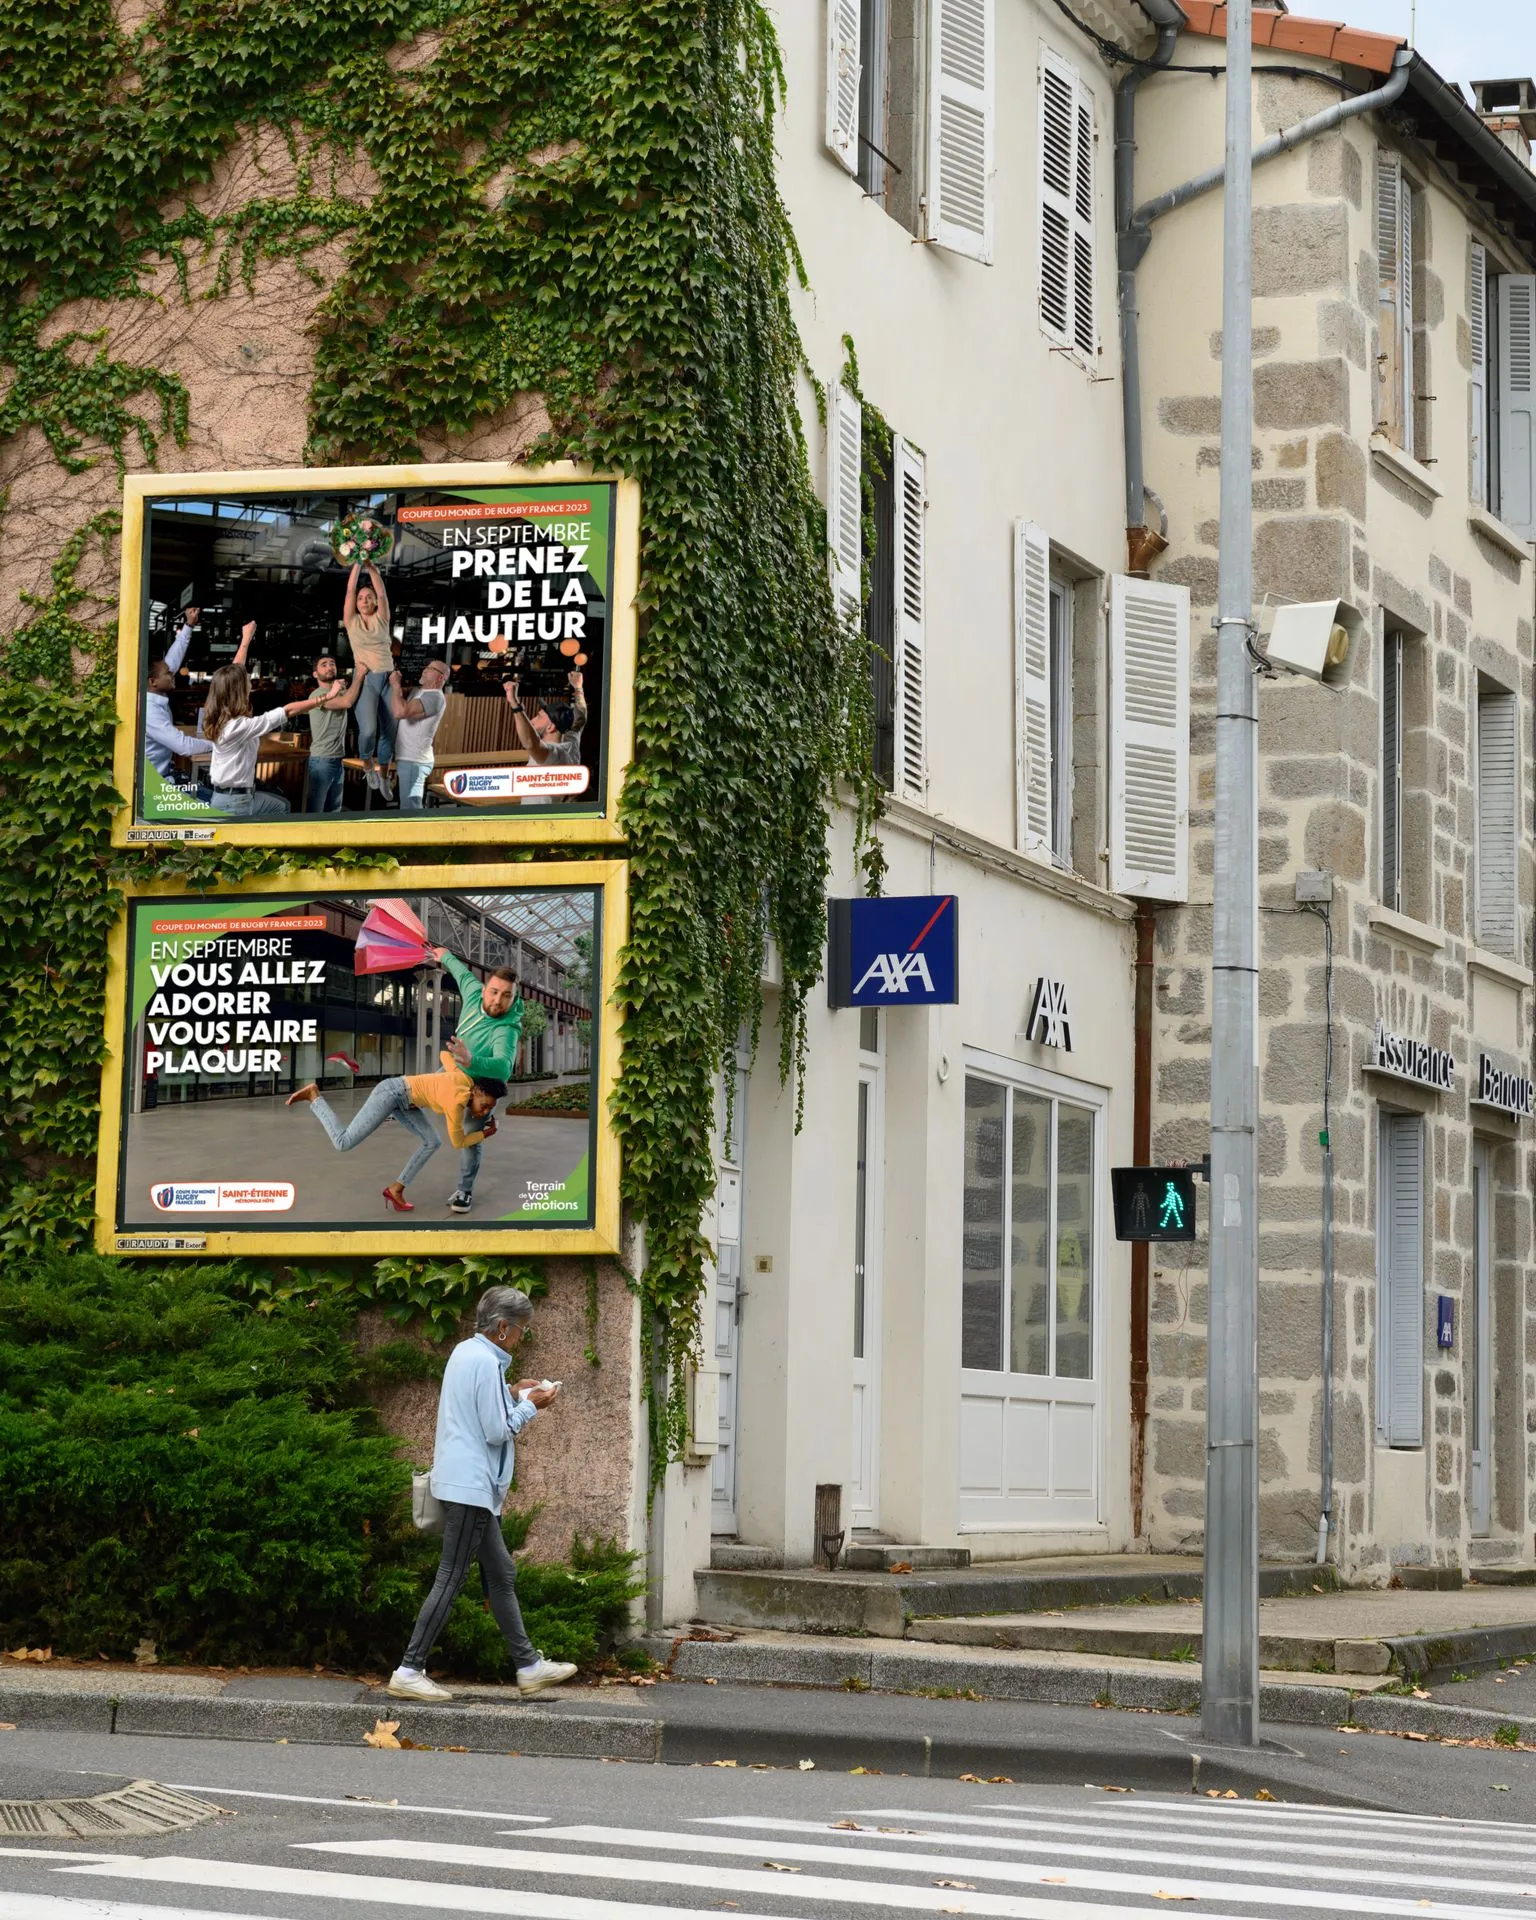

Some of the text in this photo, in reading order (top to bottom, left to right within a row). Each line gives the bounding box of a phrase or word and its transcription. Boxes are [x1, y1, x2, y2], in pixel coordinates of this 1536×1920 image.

[402, 503, 588, 519] COUPE DU MONDE DE RUGBY FRANCE 2023
[443, 522, 591, 546] EN SEPTEMBRE
[452, 544, 589, 578] PRENEZ
[487, 578, 588, 609] DE LA
[421, 611, 587, 645] HAUTEUR
[160, 782, 198, 793] Terrain
[516, 772, 583, 783] SAINT-ÉTIENNE
[156, 801, 210, 812] émotions
[161, 793, 182, 801] vos
[156, 923, 183, 931] COUPE
[197, 922, 227, 930] MONDE
[229, 921, 240, 929] DE
[241, 920, 269, 929] RUGBY
[269, 920, 302, 928] FRANCE
[303, 919, 323, 927] 2023
[151, 937, 293, 960] EN SEPTEMBRE
[150, 960, 326, 987] VOUS ALLEZ
[852, 952, 936, 995] AXA
[147, 991, 272, 1016] ADORER
[1026, 977, 1073, 1053] AXA
[147, 1019, 318, 1046] VOUS FAIRE
[145, 1049, 282, 1075] PLAQUER
[1374, 1018, 1456, 1090] Assurance
[1479, 1053, 1535, 1124] Banque
[222, 1188, 288, 1198] SAINT-ÉTIENNE
[526, 1180, 566, 1191] Terrain
[527, 1191, 550, 1200] vos
[522, 1199, 579, 1211] émotions
